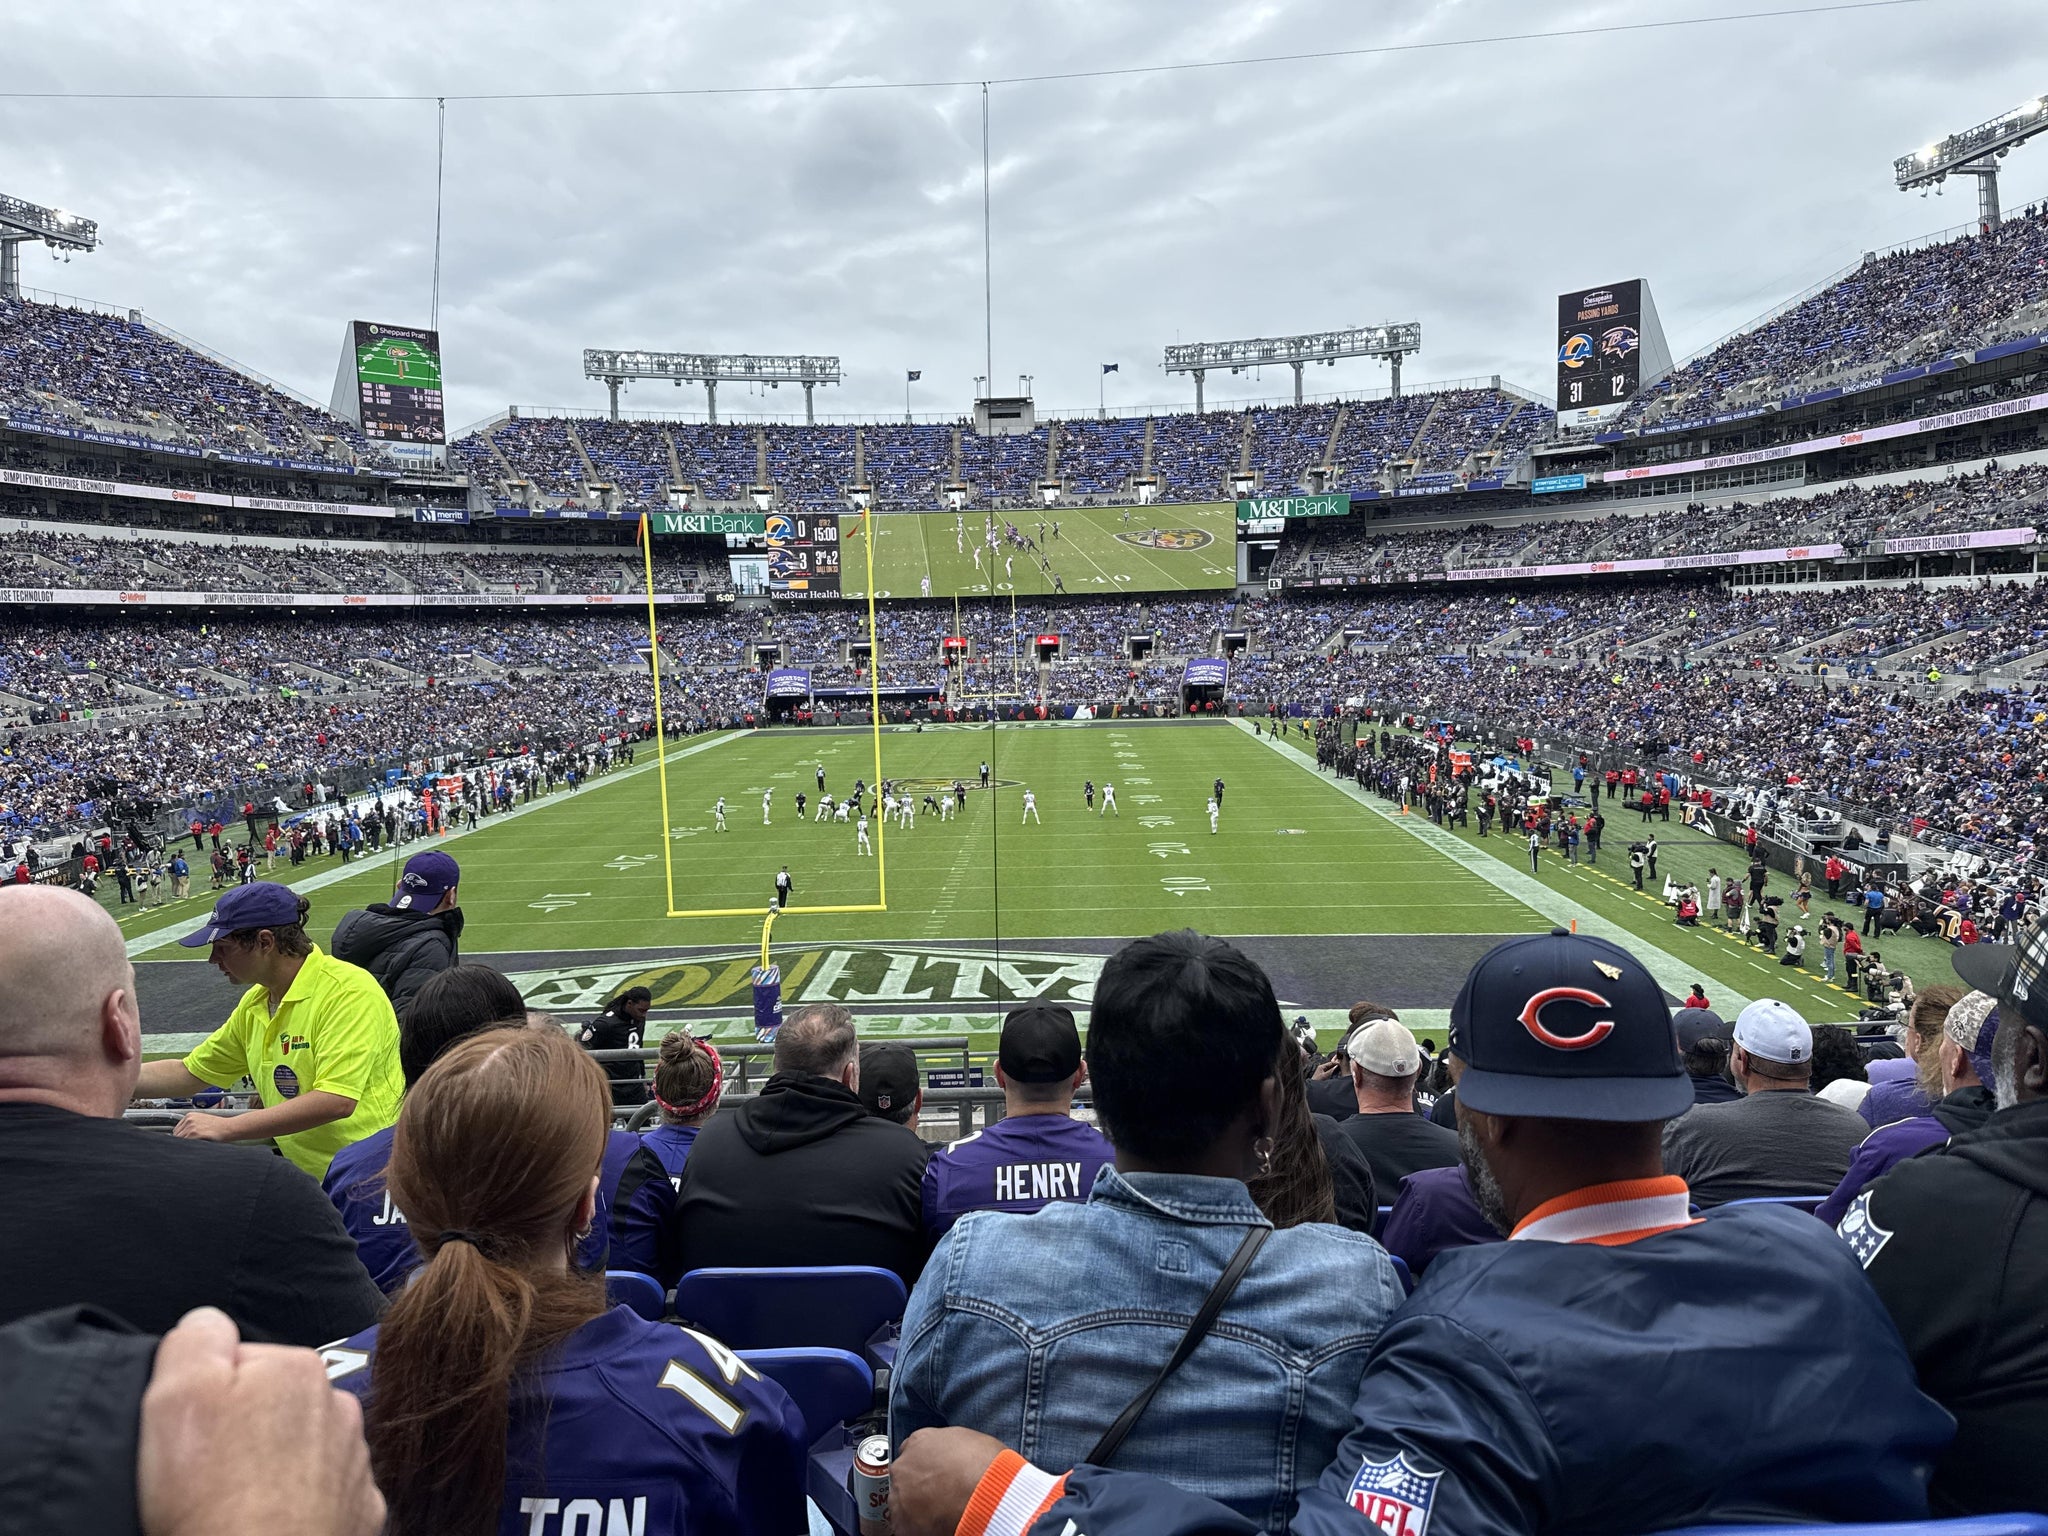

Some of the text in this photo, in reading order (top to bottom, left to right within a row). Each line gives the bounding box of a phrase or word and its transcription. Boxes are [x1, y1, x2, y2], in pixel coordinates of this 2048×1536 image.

[1577, 308, 1600, 321] PASSING
[1600, 304, 1619, 317] YARDS
[379, 326, 427, 340] Sheppard Pratt
[1570, 375, 1624, 403] 31 12
[1842, 384, 1857, 395] RING
[1859, 377, 1883, 391] HONOR
[1577, 415, 1599, 424] MedStar
[1918, 399, 2031, 432] SIMPLIFYING ENTERPRISE TECHNOLOGY
[21, 422, 42, 432] STOVER
[1666, 424, 1681, 433] YANDA
[83, 432, 100, 441] JAMAL
[100, 435, 115, 444] LEWIS
[393, 446, 433, 456] Constellation
[1703, 446, 1792, 469] SIMPLIFYING ENTERPRISE TECHNOLOGY
[3, 470, 116, 494] SIMPLIFYING ENTERPRISE TECHNOLOGY
[249, 498, 349, 514] SIMPLIFYING ENTERPRISE TECHNOLOGY
[1249, 498, 1339, 518] M&T Bank
[437, 511, 464, 521] merritt
[664, 514, 754, 533] M&T Bank
[797, 520, 806, 538] 0
[813, 527, 837, 541] 15:00
[1897, 537, 1931, 551] ENTERPRISE
[1932, 534, 1971, 549] TECHNOLOGY
[799, 552, 808, 570] 3
[815, 550, 827, 566] 3rd
[831, 550, 839, 565] 2
[1663, 553, 1740, 569] SIMPLIFYING ENTERPRISE TECHNOLOGY
[1471, 568, 1503, 579] ENTERPRISE
[1504, 567, 1537, 578] TECHNOLOGY
[1319, 577, 1344, 586] MONEYLINE
[13, 590, 54, 603] TECHNOLOGY
[203, 593, 295, 604] SIMPLIFYING ENTERPRISE TECHNOLOGY
[423, 595, 526, 604] SIMPLIFYING ENTERPRISE TECHNOLOGY
[716, 594, 735, 602] 15:00
[771, 589, 840, 600] MedStar Health
[1160, 876, 1211, 893] 10
[528, 892, 592, 908] 10
[1517, 987, 1615, 1051] C
[996, 1162, 1081, 1200] HENRY
[1353, 1491, 1413, 1536] NFL
